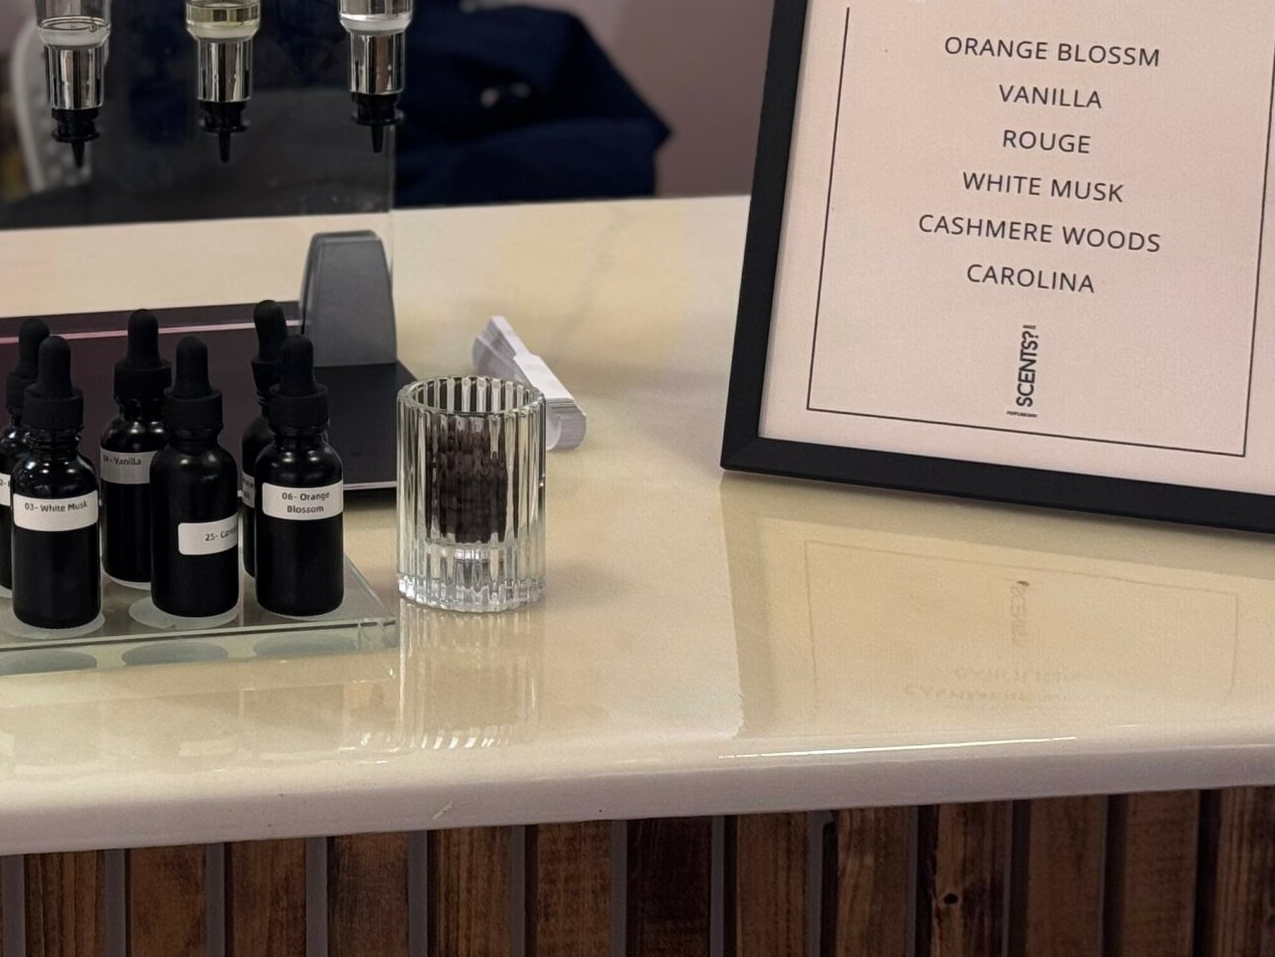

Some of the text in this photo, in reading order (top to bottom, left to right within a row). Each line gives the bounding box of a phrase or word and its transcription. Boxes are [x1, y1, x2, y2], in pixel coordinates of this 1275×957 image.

[944, 36, 1160, 67] ORANGE BLOSSM
[998, 84, 1102, 109] VANILLA
[1002, 129, 1091, 154] ROUGE
[962, 171, 1124, 203] WHITE MUSK
[918, 214, 1161, 253] CASHMERE WOODS
[966, 264, 1095, 294] CAROLINA
[114, 457, 142, 466] Vanilla
[24, 500, 88, 512] 03- White Musk
[281, 492, 330, 501] 06- Orange
[287, 504, 324, 514] Blossom
[205, 533, 220, 542] 25-
